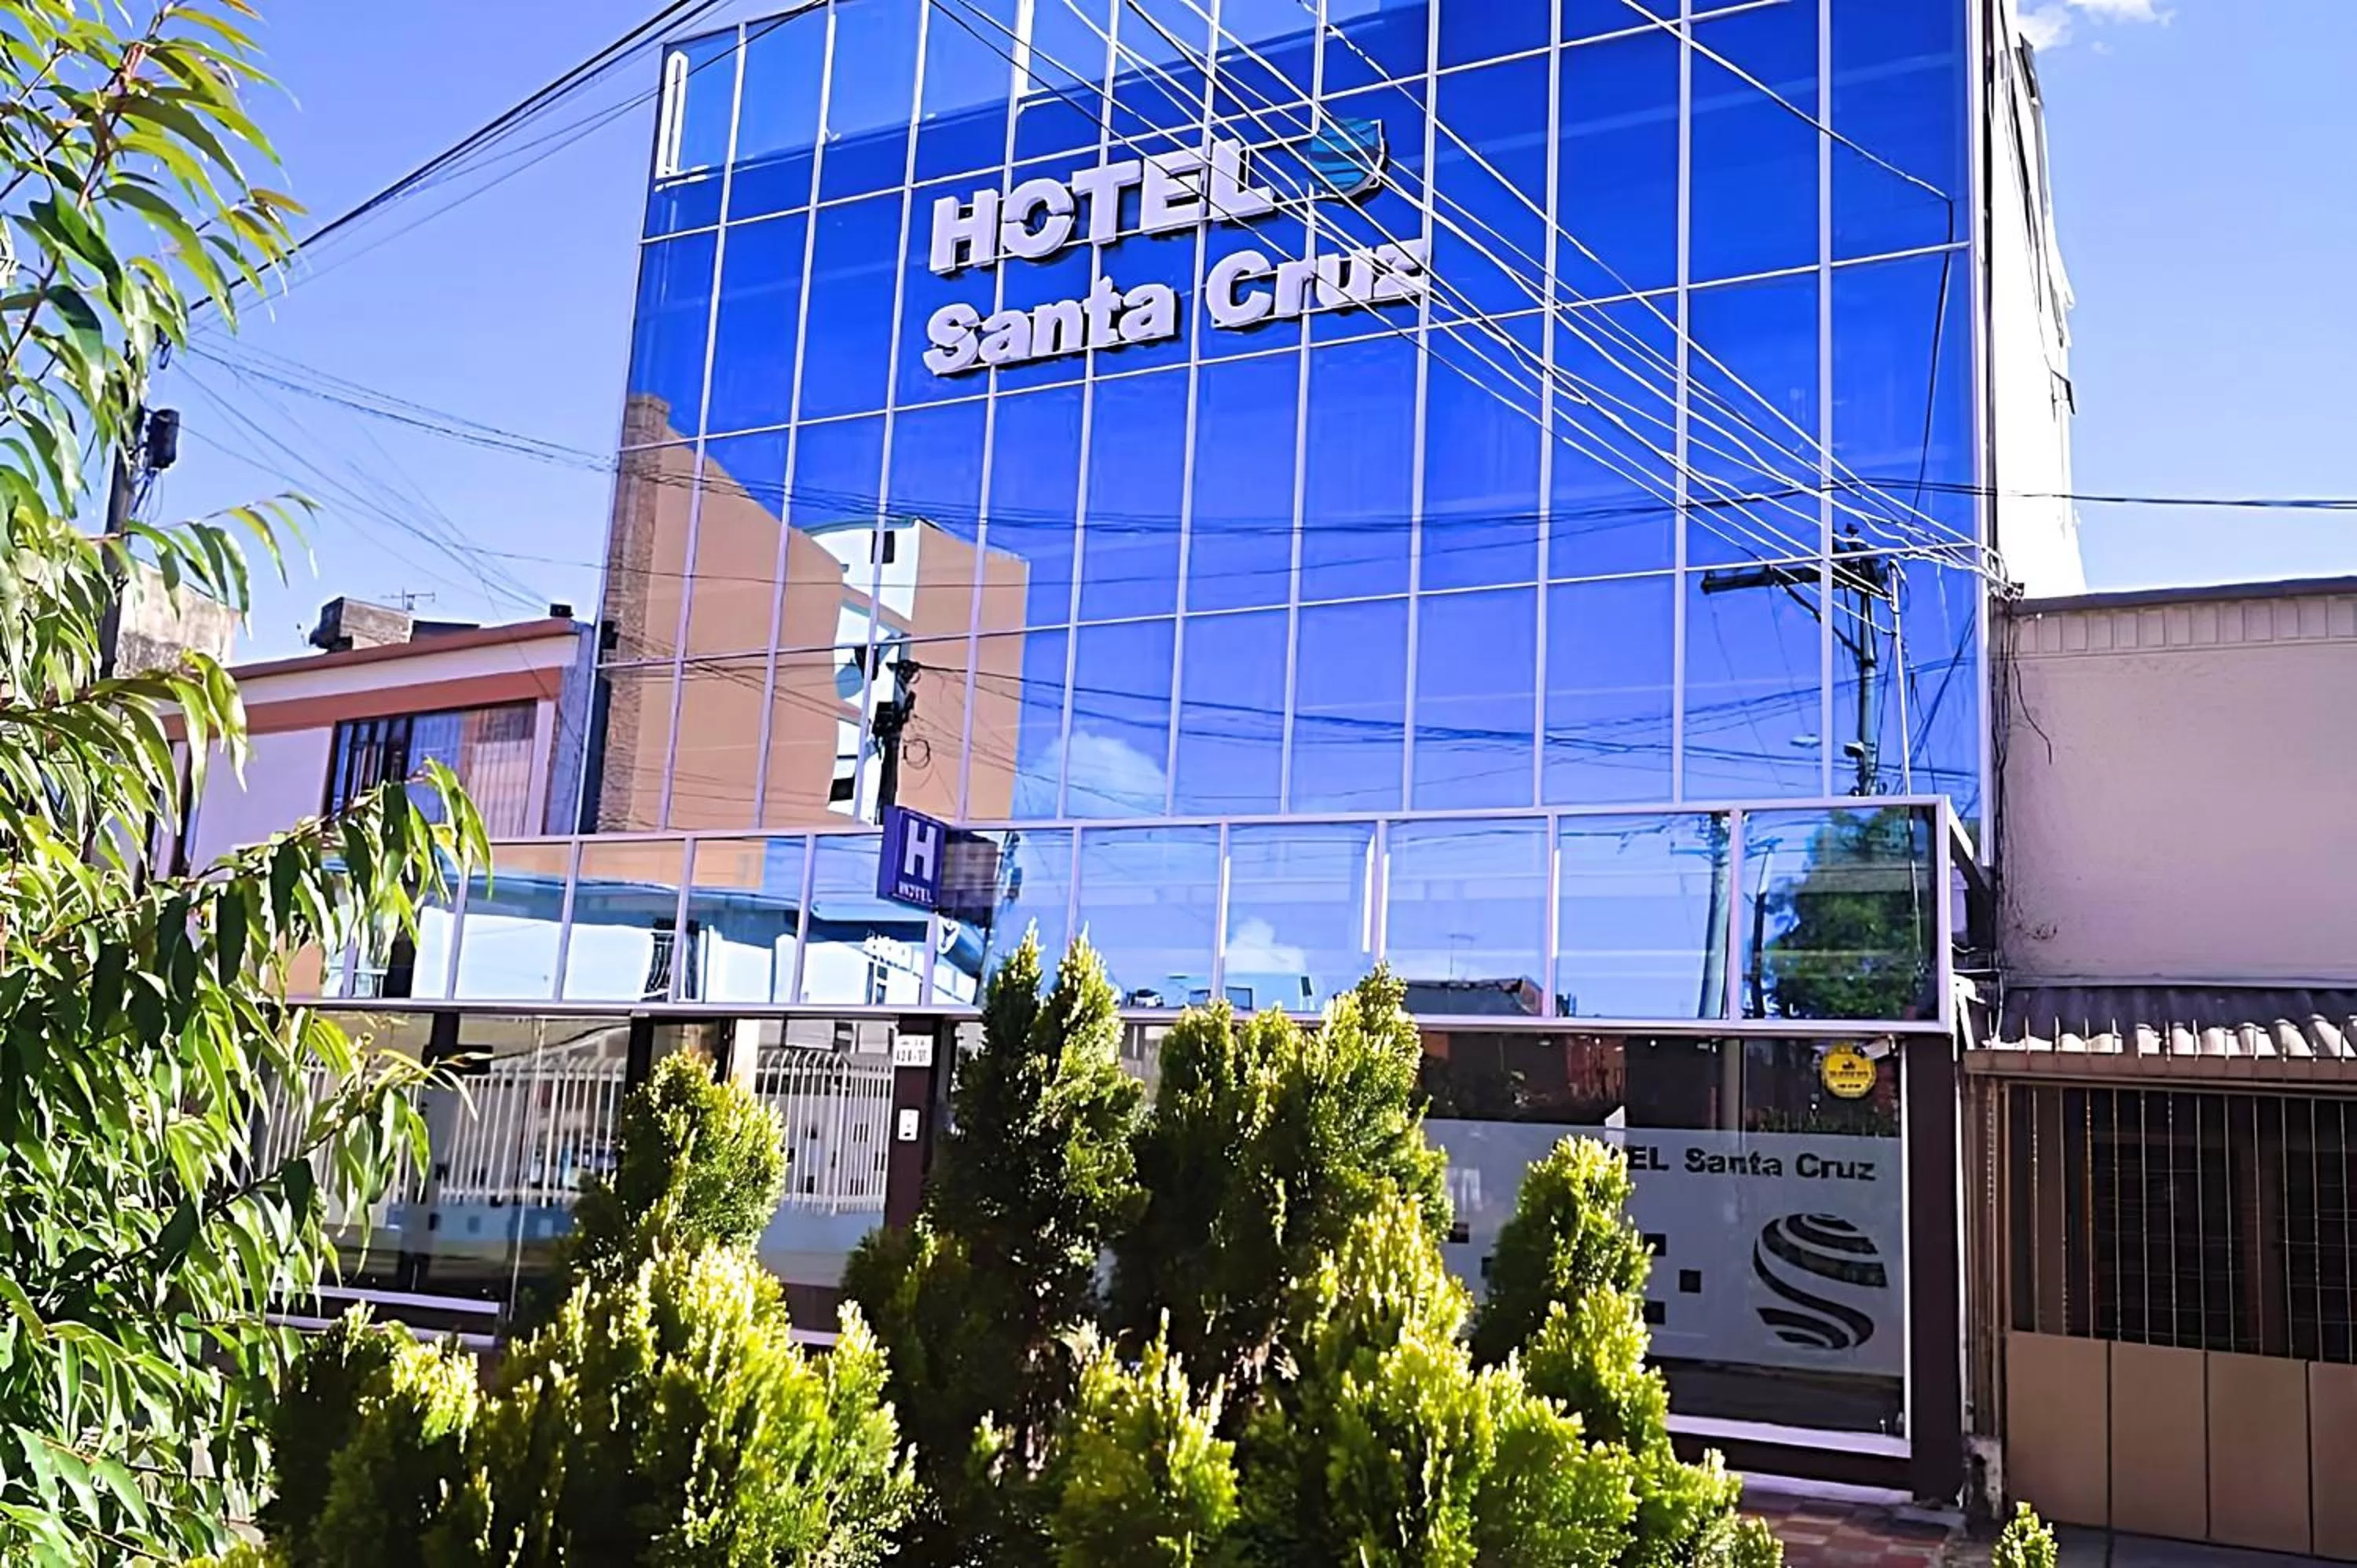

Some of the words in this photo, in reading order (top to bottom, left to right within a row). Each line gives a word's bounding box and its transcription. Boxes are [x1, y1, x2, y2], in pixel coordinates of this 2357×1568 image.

[929, 139, 1274, 273] HOTEL
[922, 276, 1176, 376] Santa
[1204, 238, 1427, 328] Cruz
[904, 819, 937, 881] H
[1624, 1145, 1670, 1171] EL
[1684, 1148, 1782, 1177] Santa
[1796, 1152, 1876, 1181] Cruz
